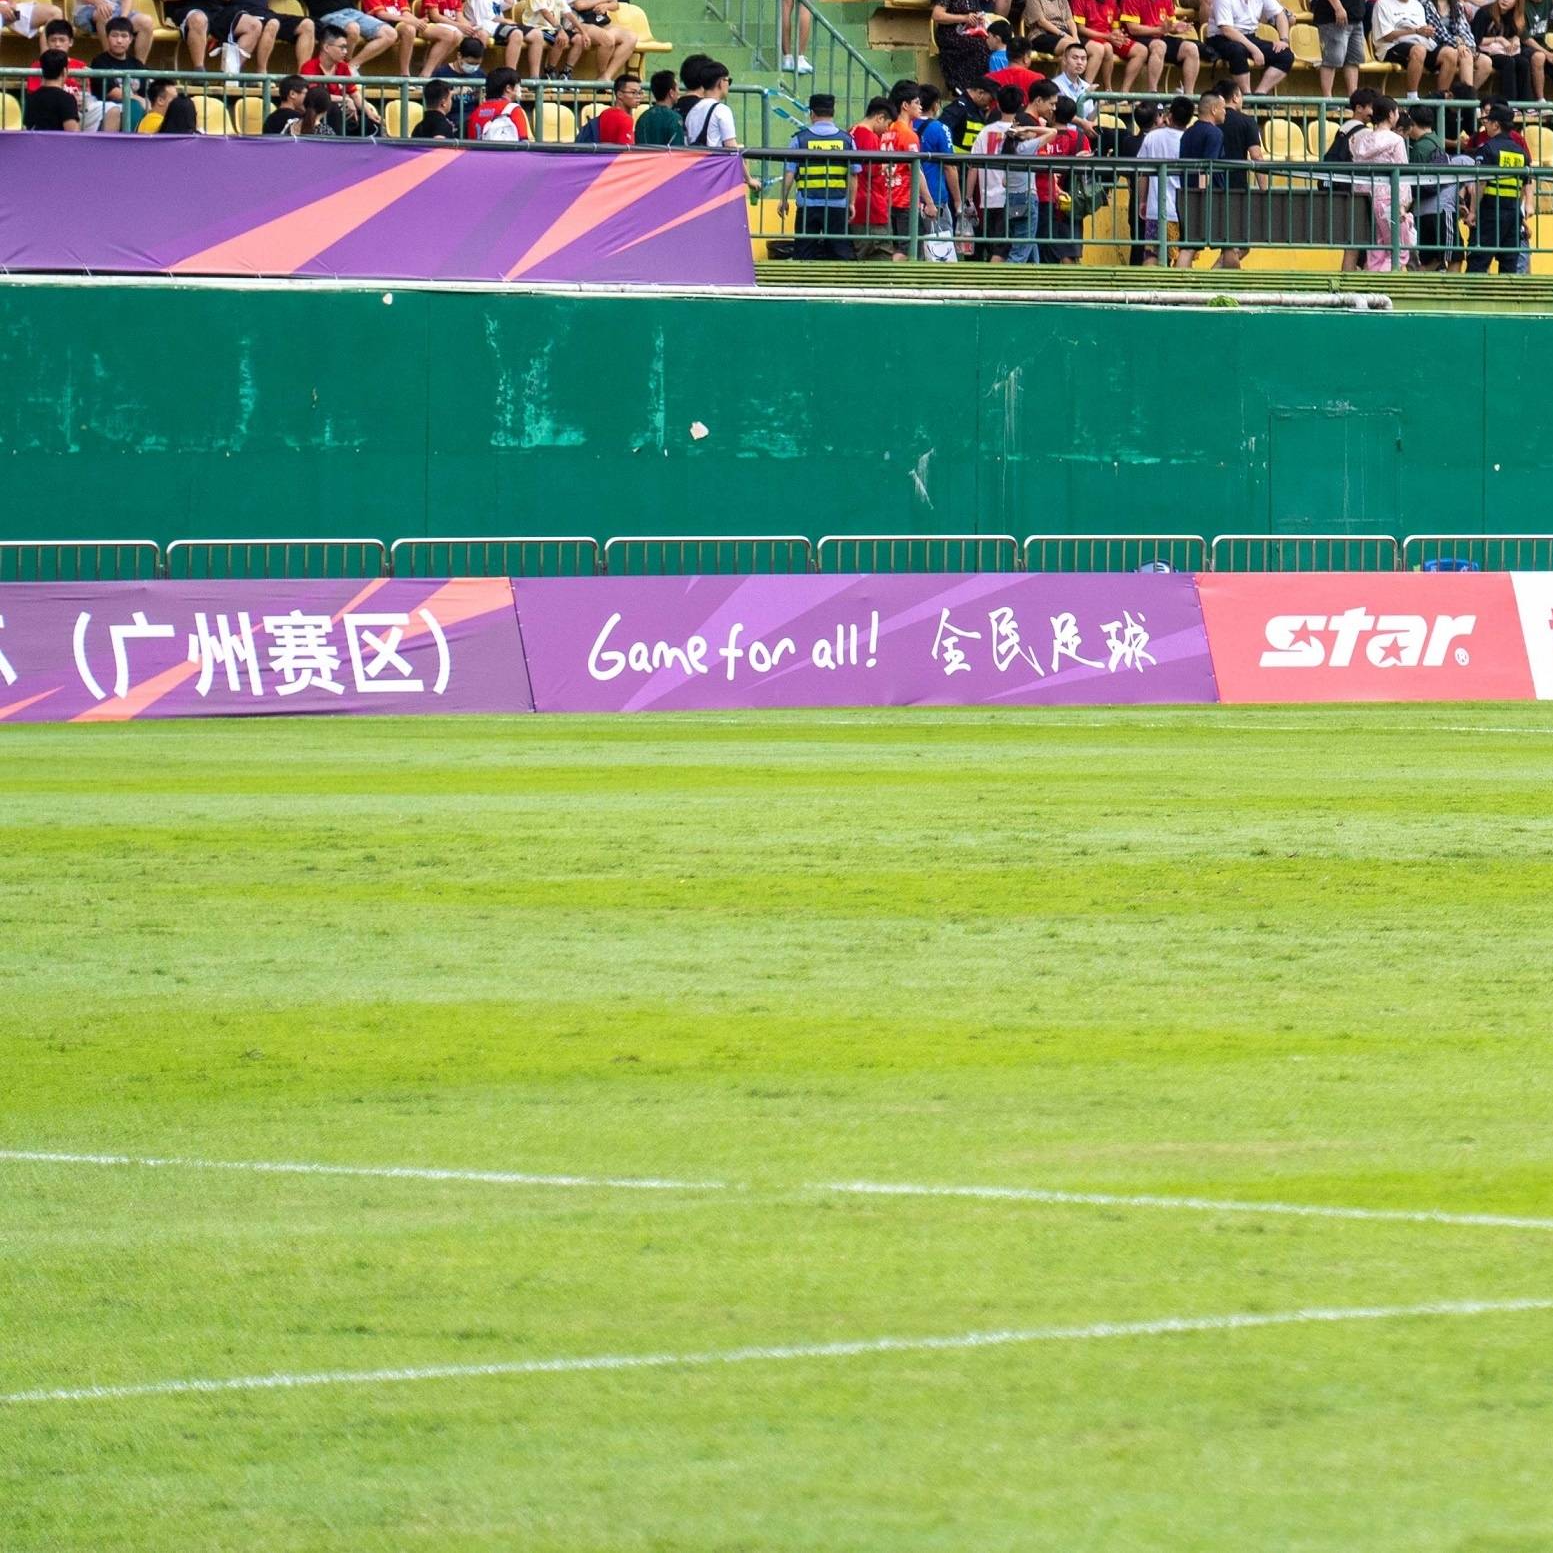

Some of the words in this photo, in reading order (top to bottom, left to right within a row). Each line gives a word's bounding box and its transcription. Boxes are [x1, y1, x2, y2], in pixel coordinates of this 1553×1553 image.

[588, 612, 708, 682] Game
[719, 622, 796, 681] for
[811, 610, 880, 671] all!
[930, 607, 1159, 679] 全民足球
[1259, 607, 1477, 668] star
